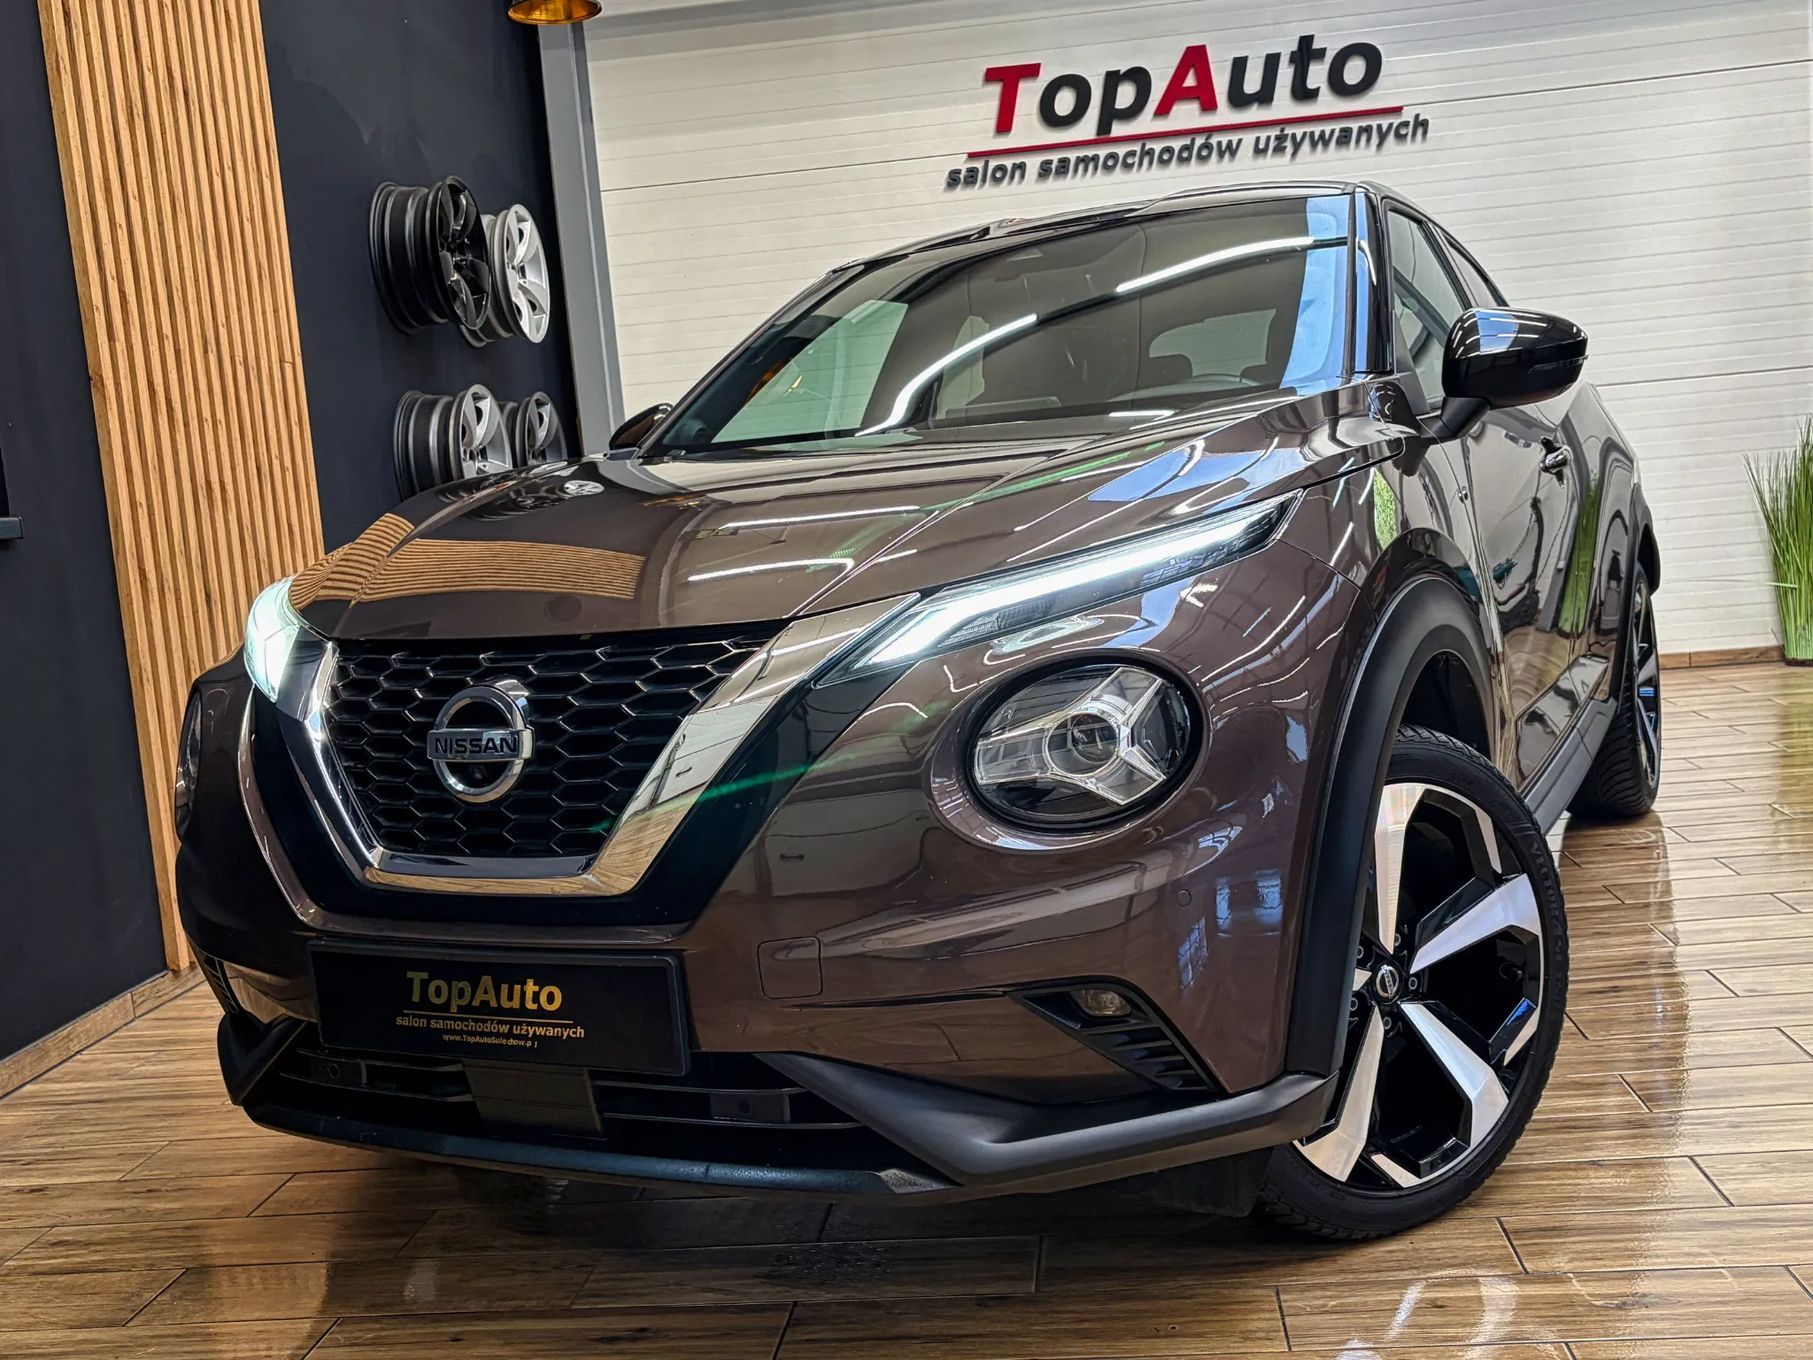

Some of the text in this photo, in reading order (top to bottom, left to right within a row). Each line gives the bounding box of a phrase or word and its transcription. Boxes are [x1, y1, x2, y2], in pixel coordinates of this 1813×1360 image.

[983, 34, 1384, 136] TopAuto
[945, 113, 1431, 189] salon samochodów używanych
[434, 735, 519, 755] NISSAN
[405, 970, 563, 1013] TopAuto
[395, 1015, 585, 1040] salon samochodów używanych
